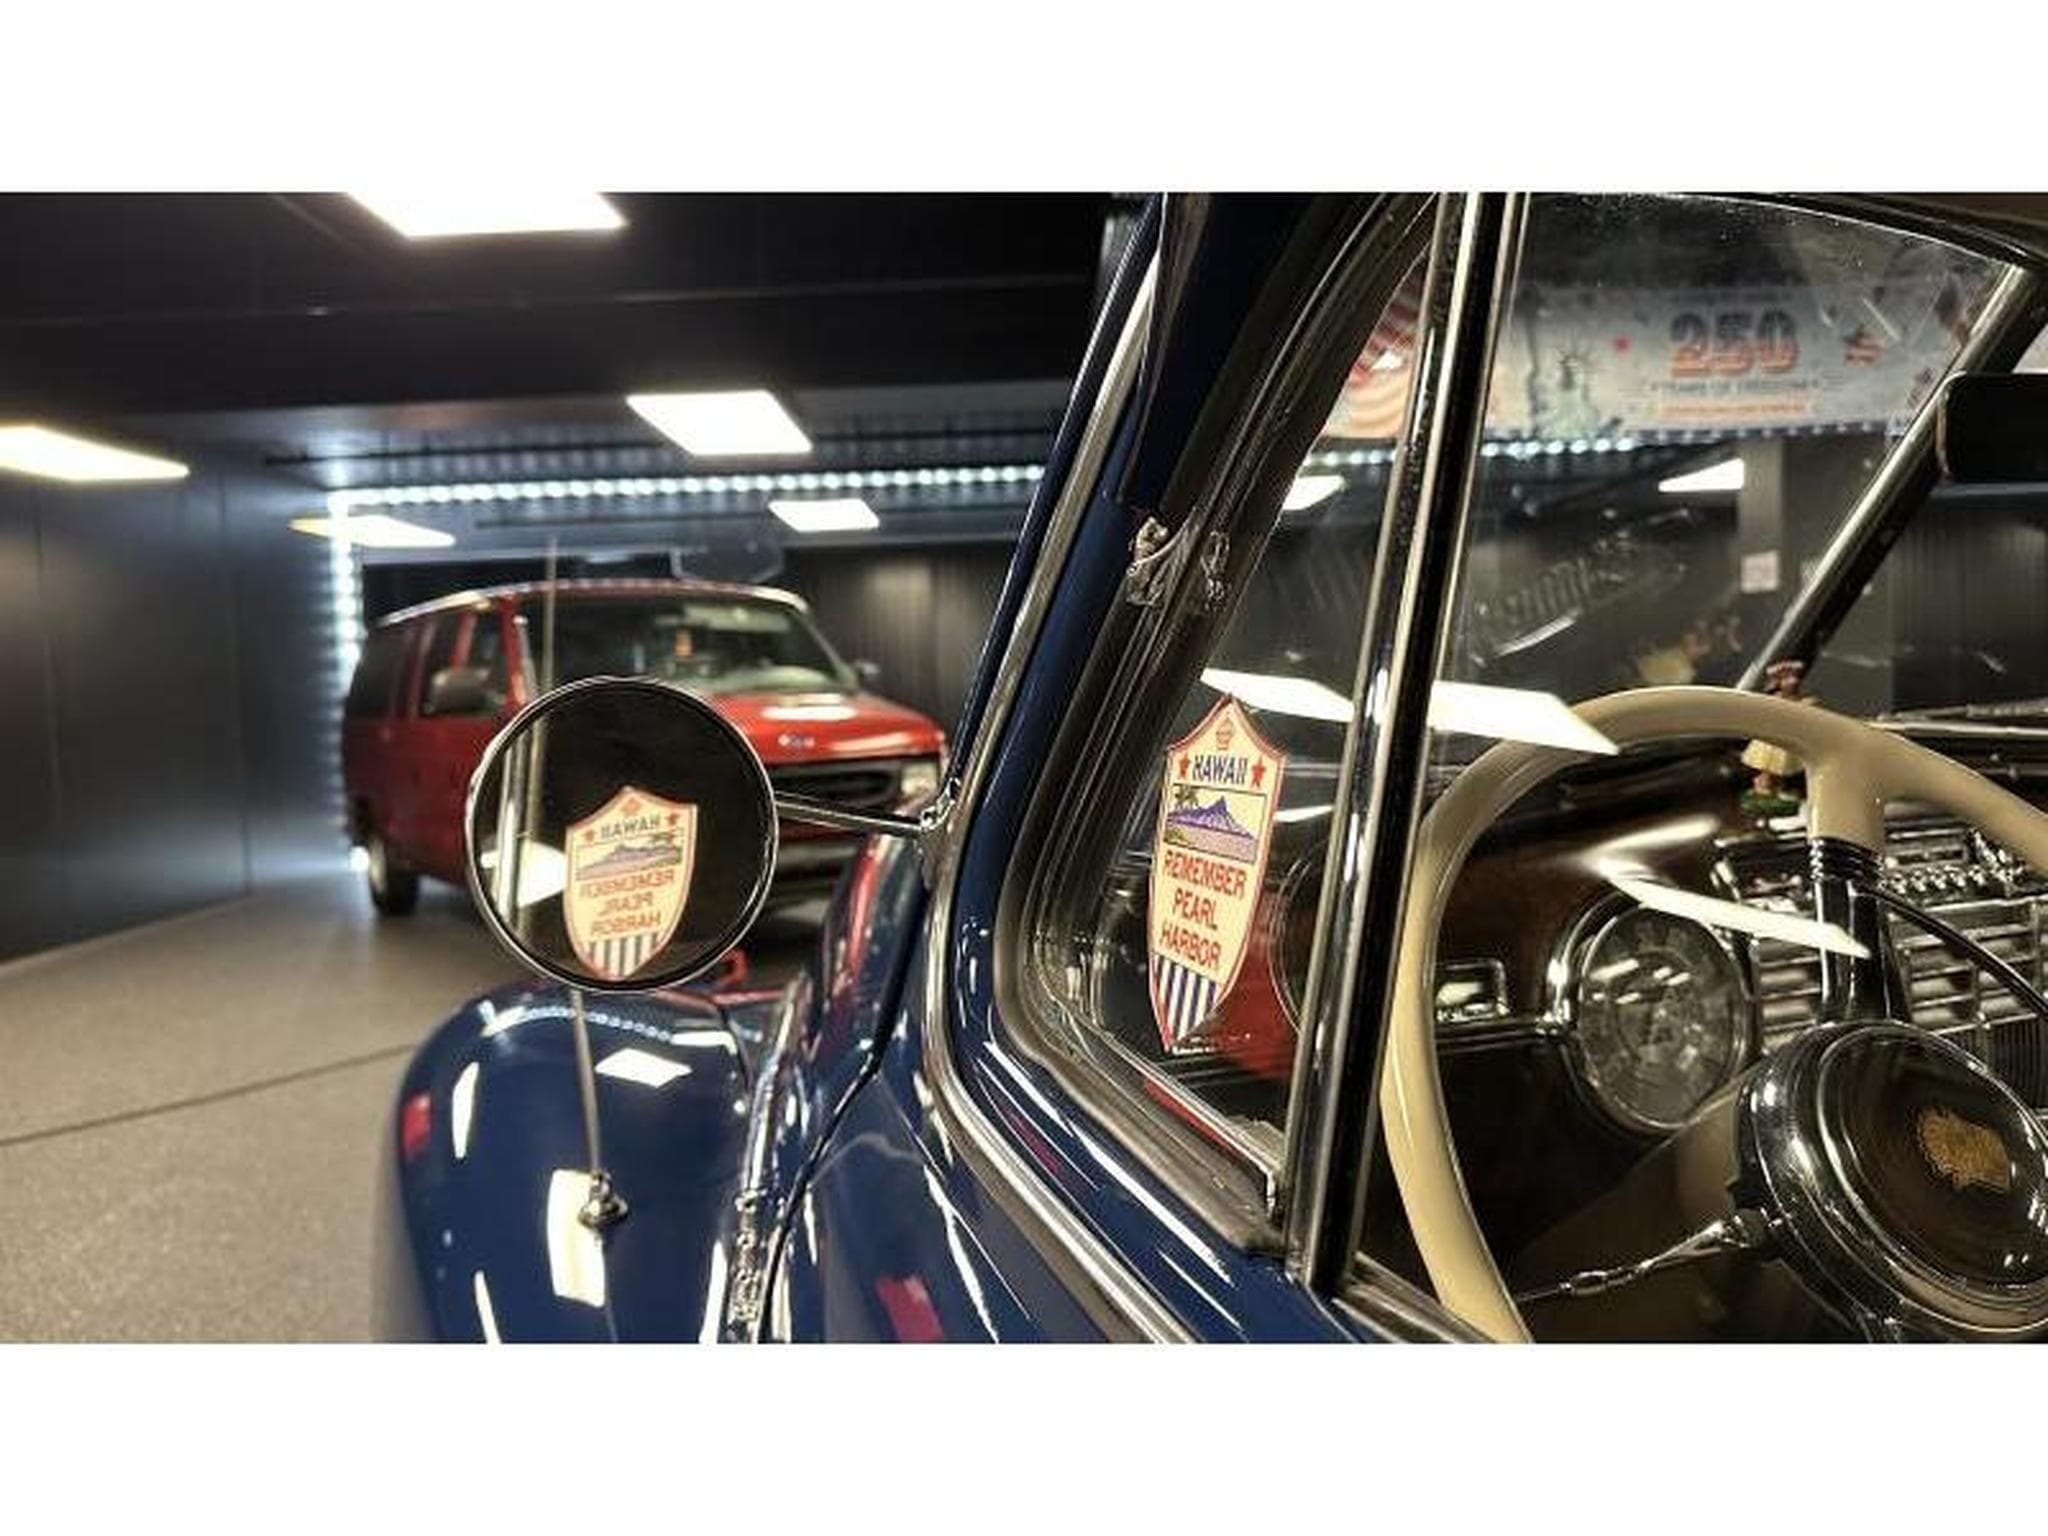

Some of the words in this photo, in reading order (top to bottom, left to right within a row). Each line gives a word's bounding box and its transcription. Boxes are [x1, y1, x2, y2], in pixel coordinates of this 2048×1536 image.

[1670, 309, 1798, 378] 250
[1191, 755, 1248, 785] HAWAII
[1164, 850, 1246, 898] REMEMBER
[1173, 887, 1219, 931] PEARL
[1159, 922, 1222, 968] HARBOR
